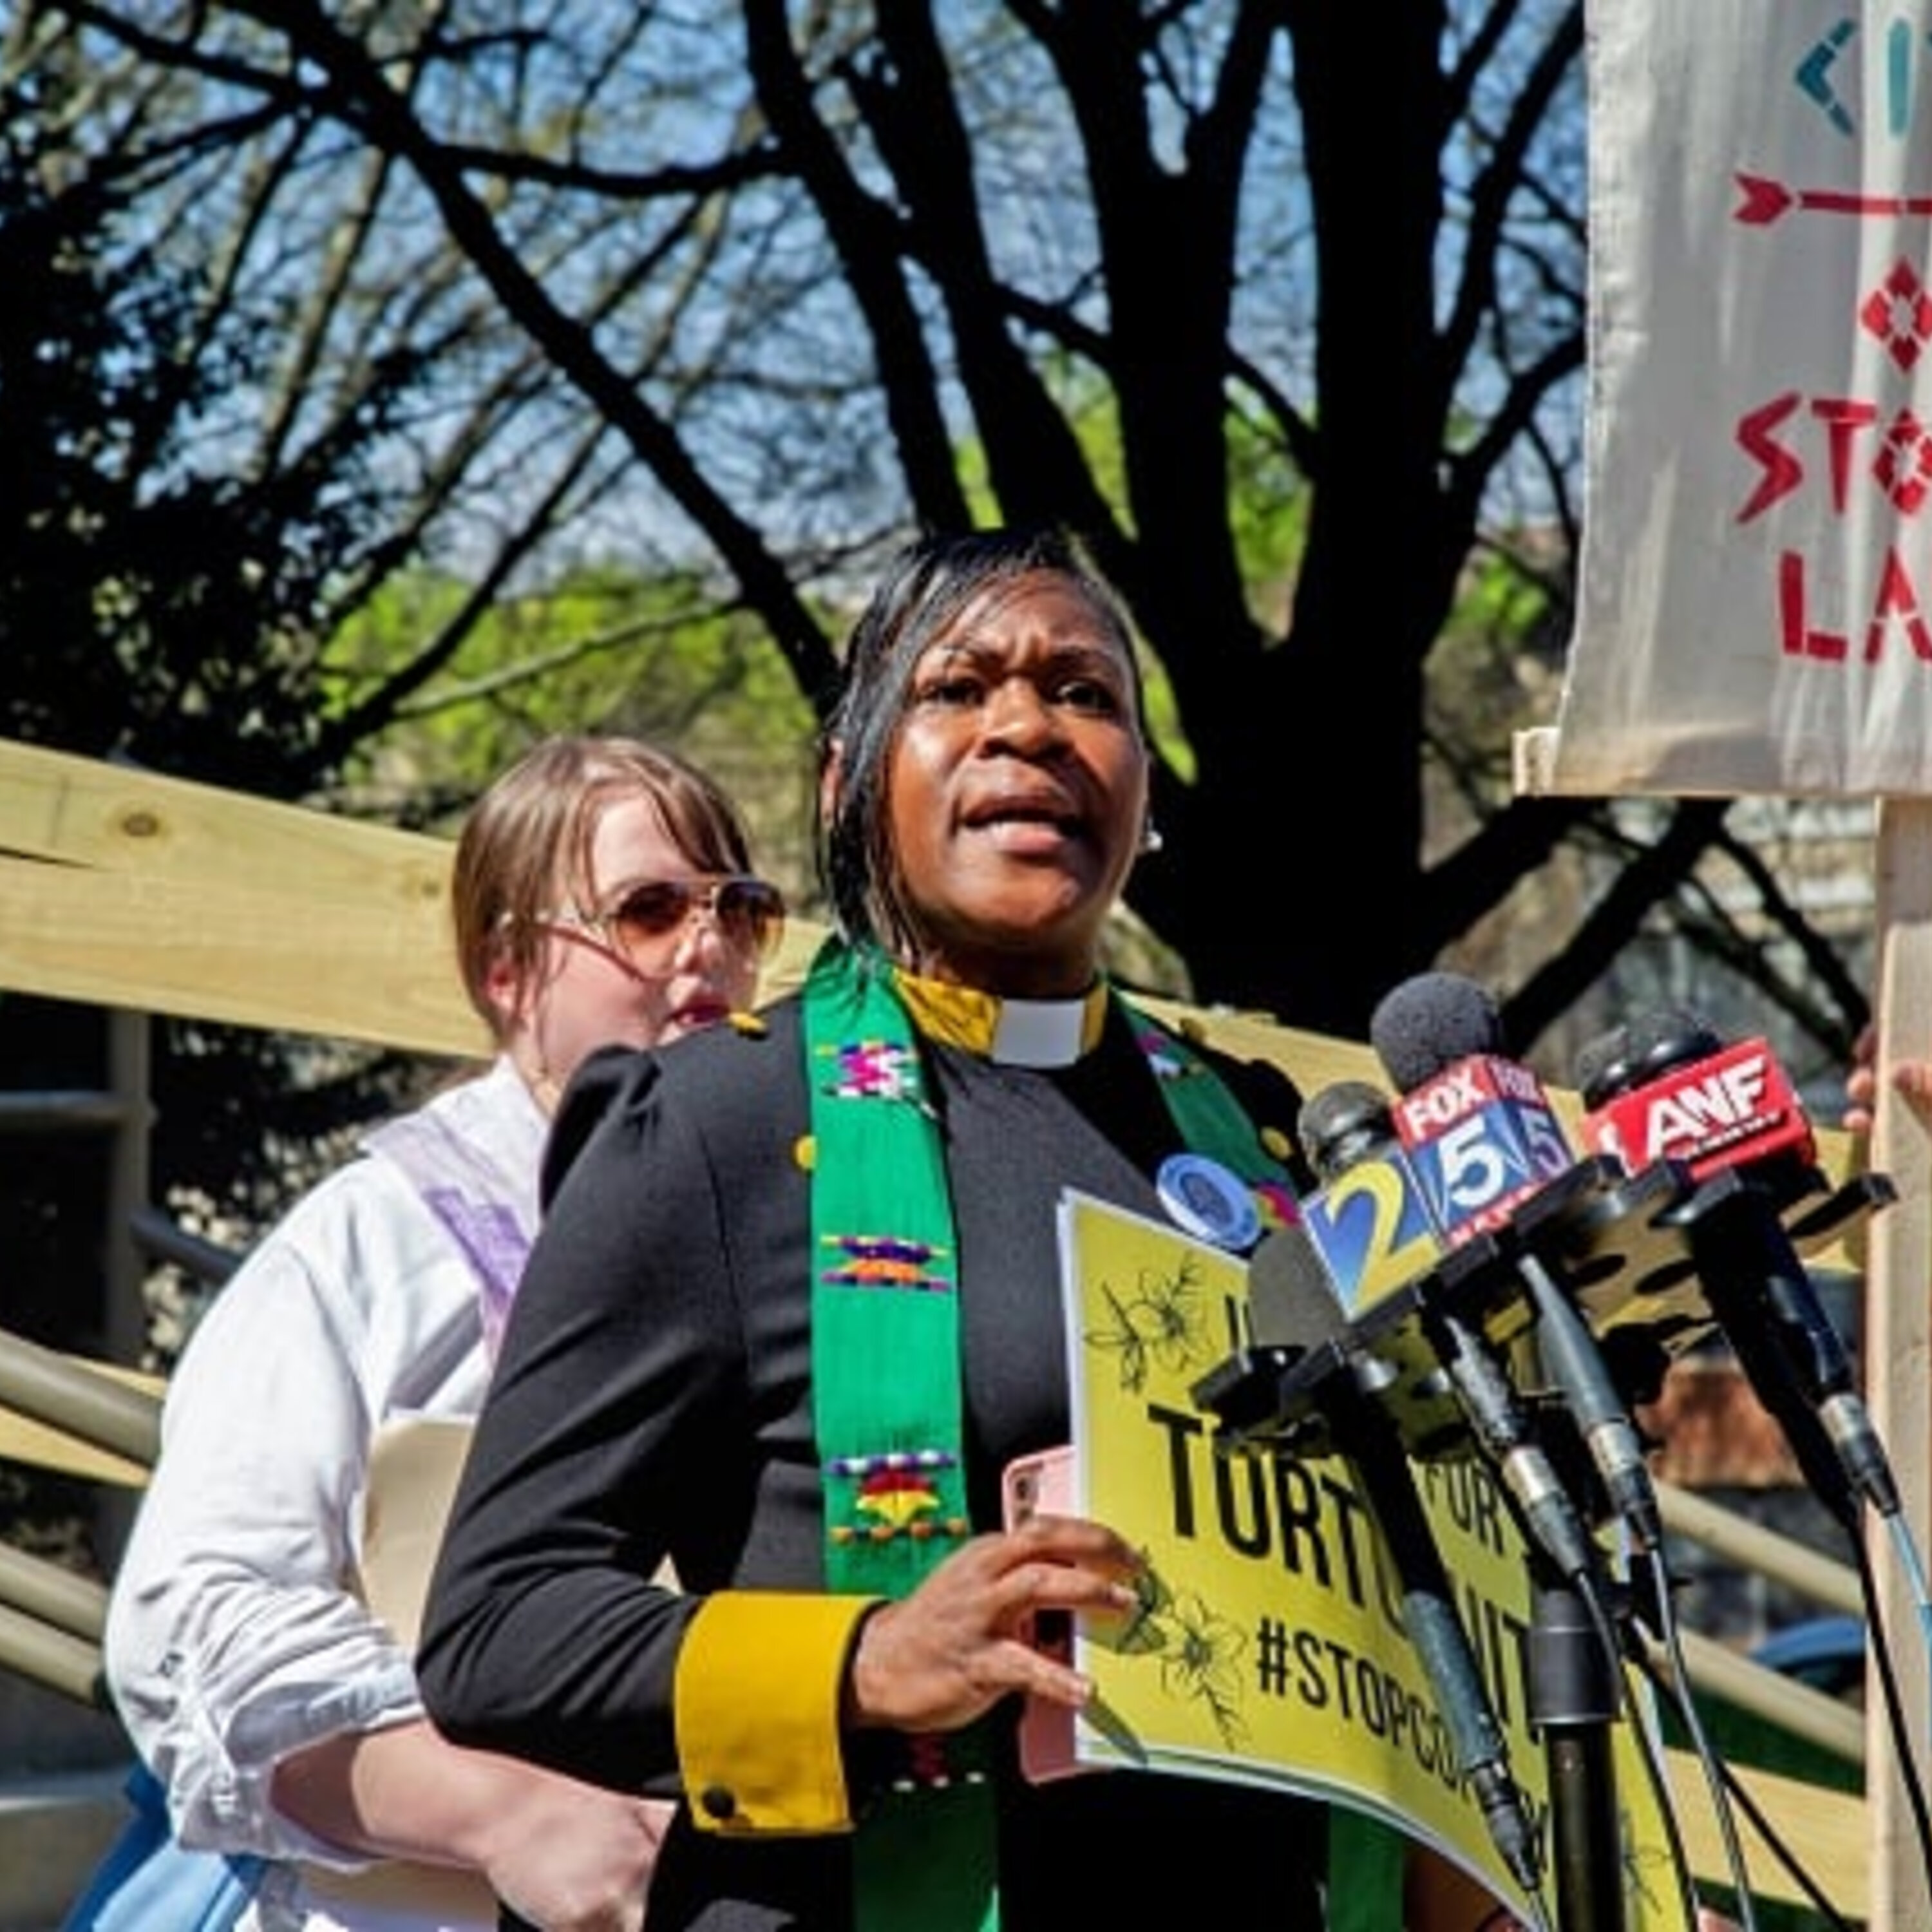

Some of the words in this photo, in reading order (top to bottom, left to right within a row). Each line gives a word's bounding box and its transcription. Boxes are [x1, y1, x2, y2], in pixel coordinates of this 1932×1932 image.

[1405, 1066, 1486, 1142] FOX
[1520, 1107, 1570, 1179] 5
[1647, 1056, 1765, 1162] ANF
[1439, 1114, 1504, 1207] 5
[1325, 1161, 1441, 1319] 2
